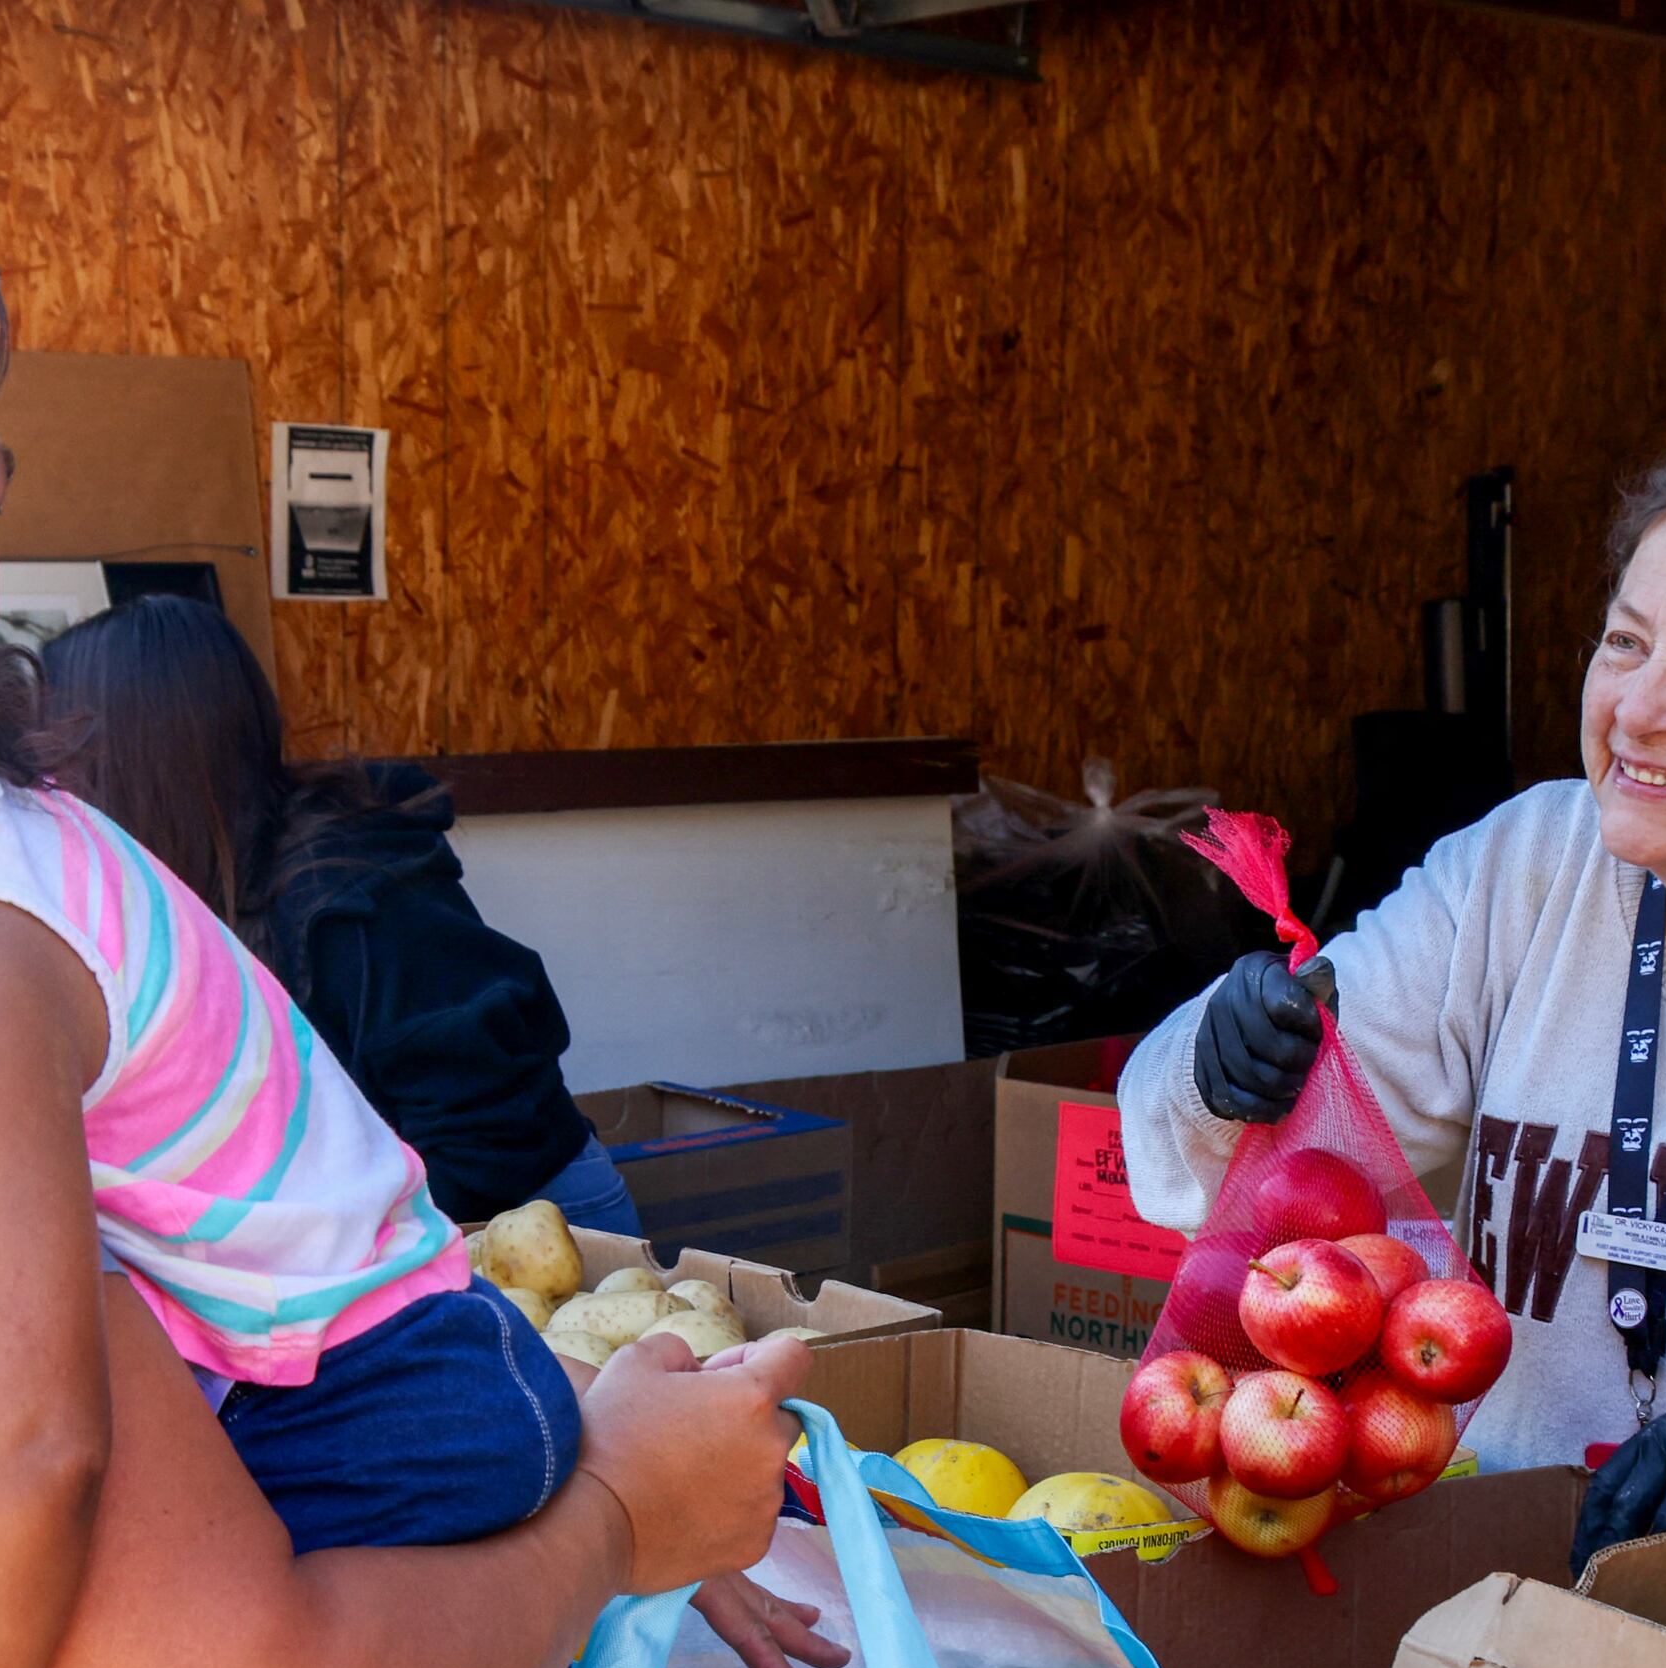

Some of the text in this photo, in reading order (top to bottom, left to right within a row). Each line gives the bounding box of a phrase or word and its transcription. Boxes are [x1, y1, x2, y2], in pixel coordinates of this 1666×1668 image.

[1614, 1217, 1628, 1228] DR.
[1630, 1220, 1653, 1232] VICKY
[1623, 1295, 1642, 1305] Love
[1623, 1311, 1642, 1321] Hurt
[1050, 1311, 1150, 1353] NORTH
